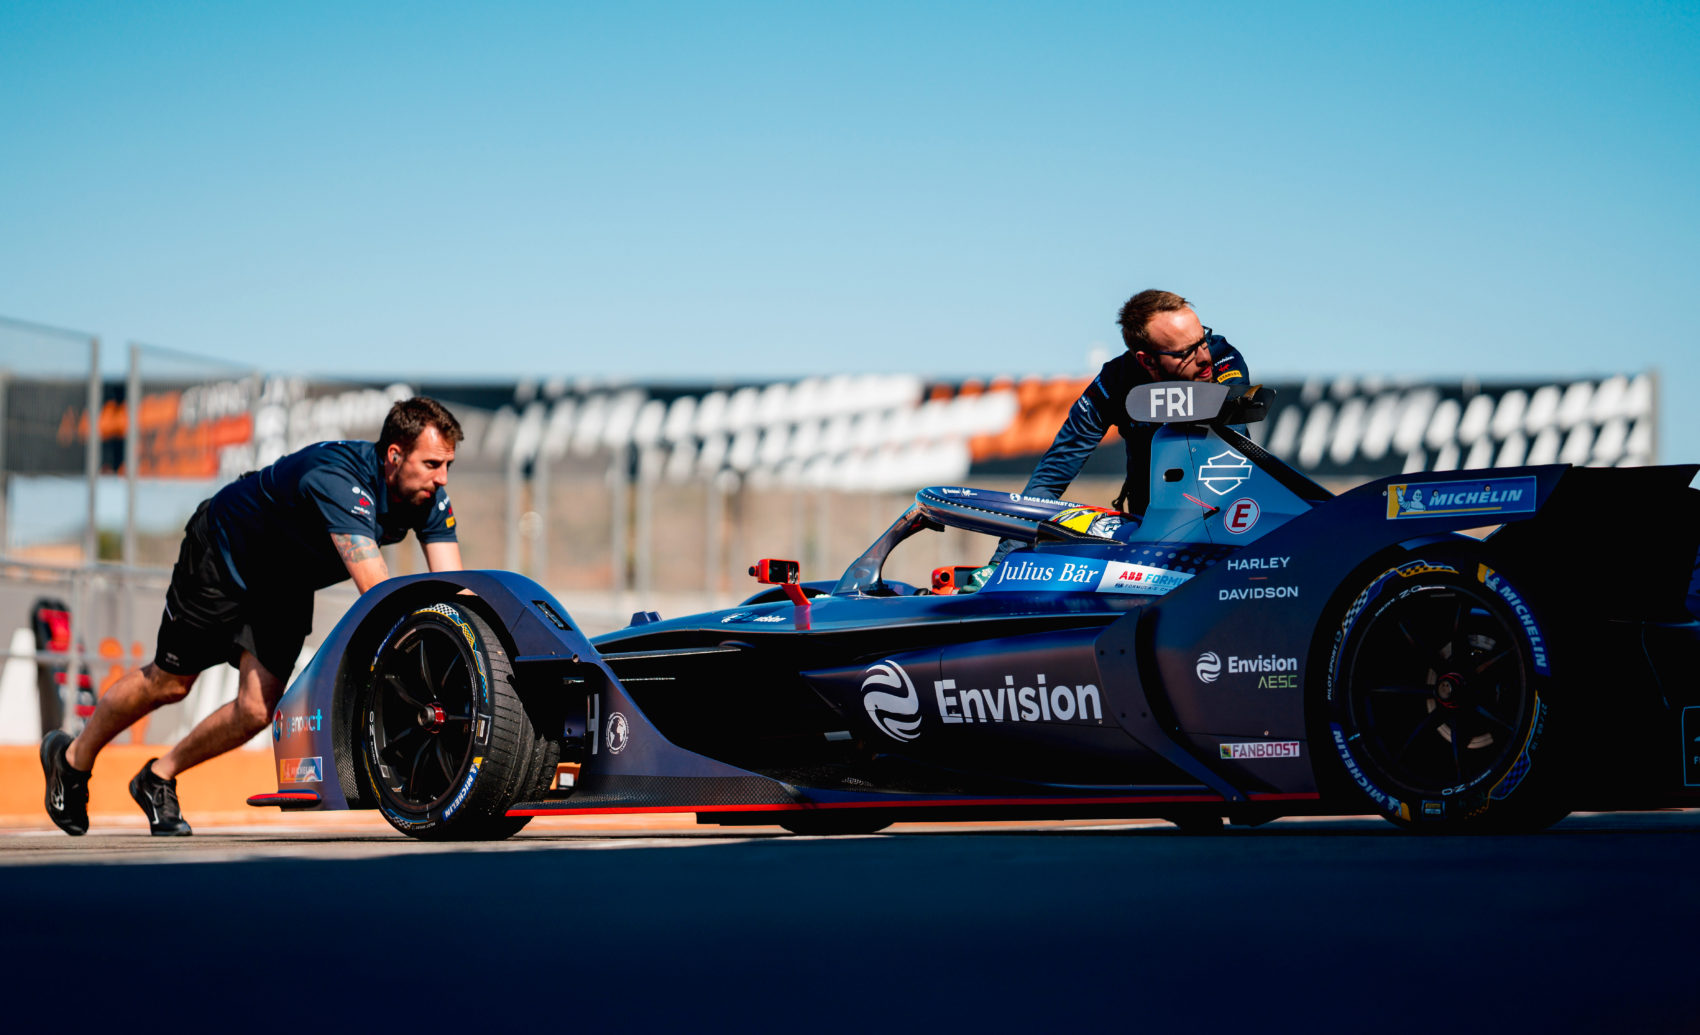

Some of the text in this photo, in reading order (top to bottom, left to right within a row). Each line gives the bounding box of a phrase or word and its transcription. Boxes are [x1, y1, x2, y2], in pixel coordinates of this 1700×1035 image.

[1150, 386, 1194, 419] FRI
[1041, 498, 1068, 507] AGAINST
[1429, 489, 1523, 506] MICHELIN
[1231, 504, 1251, 528] E
[997, 561, 1099, 584] Julius Bär
[1226, 556, 1290, 571] HARLEY
[1119, 570, 1143, 582] ABB
[1218, 586, 1299, 602] DAVIDSON
[1499, 585, 1547, 669] MICHELIN
[1227, 654, 1298, 674] Envision
[1258, 675, 1297, 688] AESC
[934, 673, 1103, 724] Envision
[1232, 742, 1299, 757] FANBOOST
[1333, 730, 1386, 803] MICHELIN
[444, 775, 474, 818] MICHELIN
